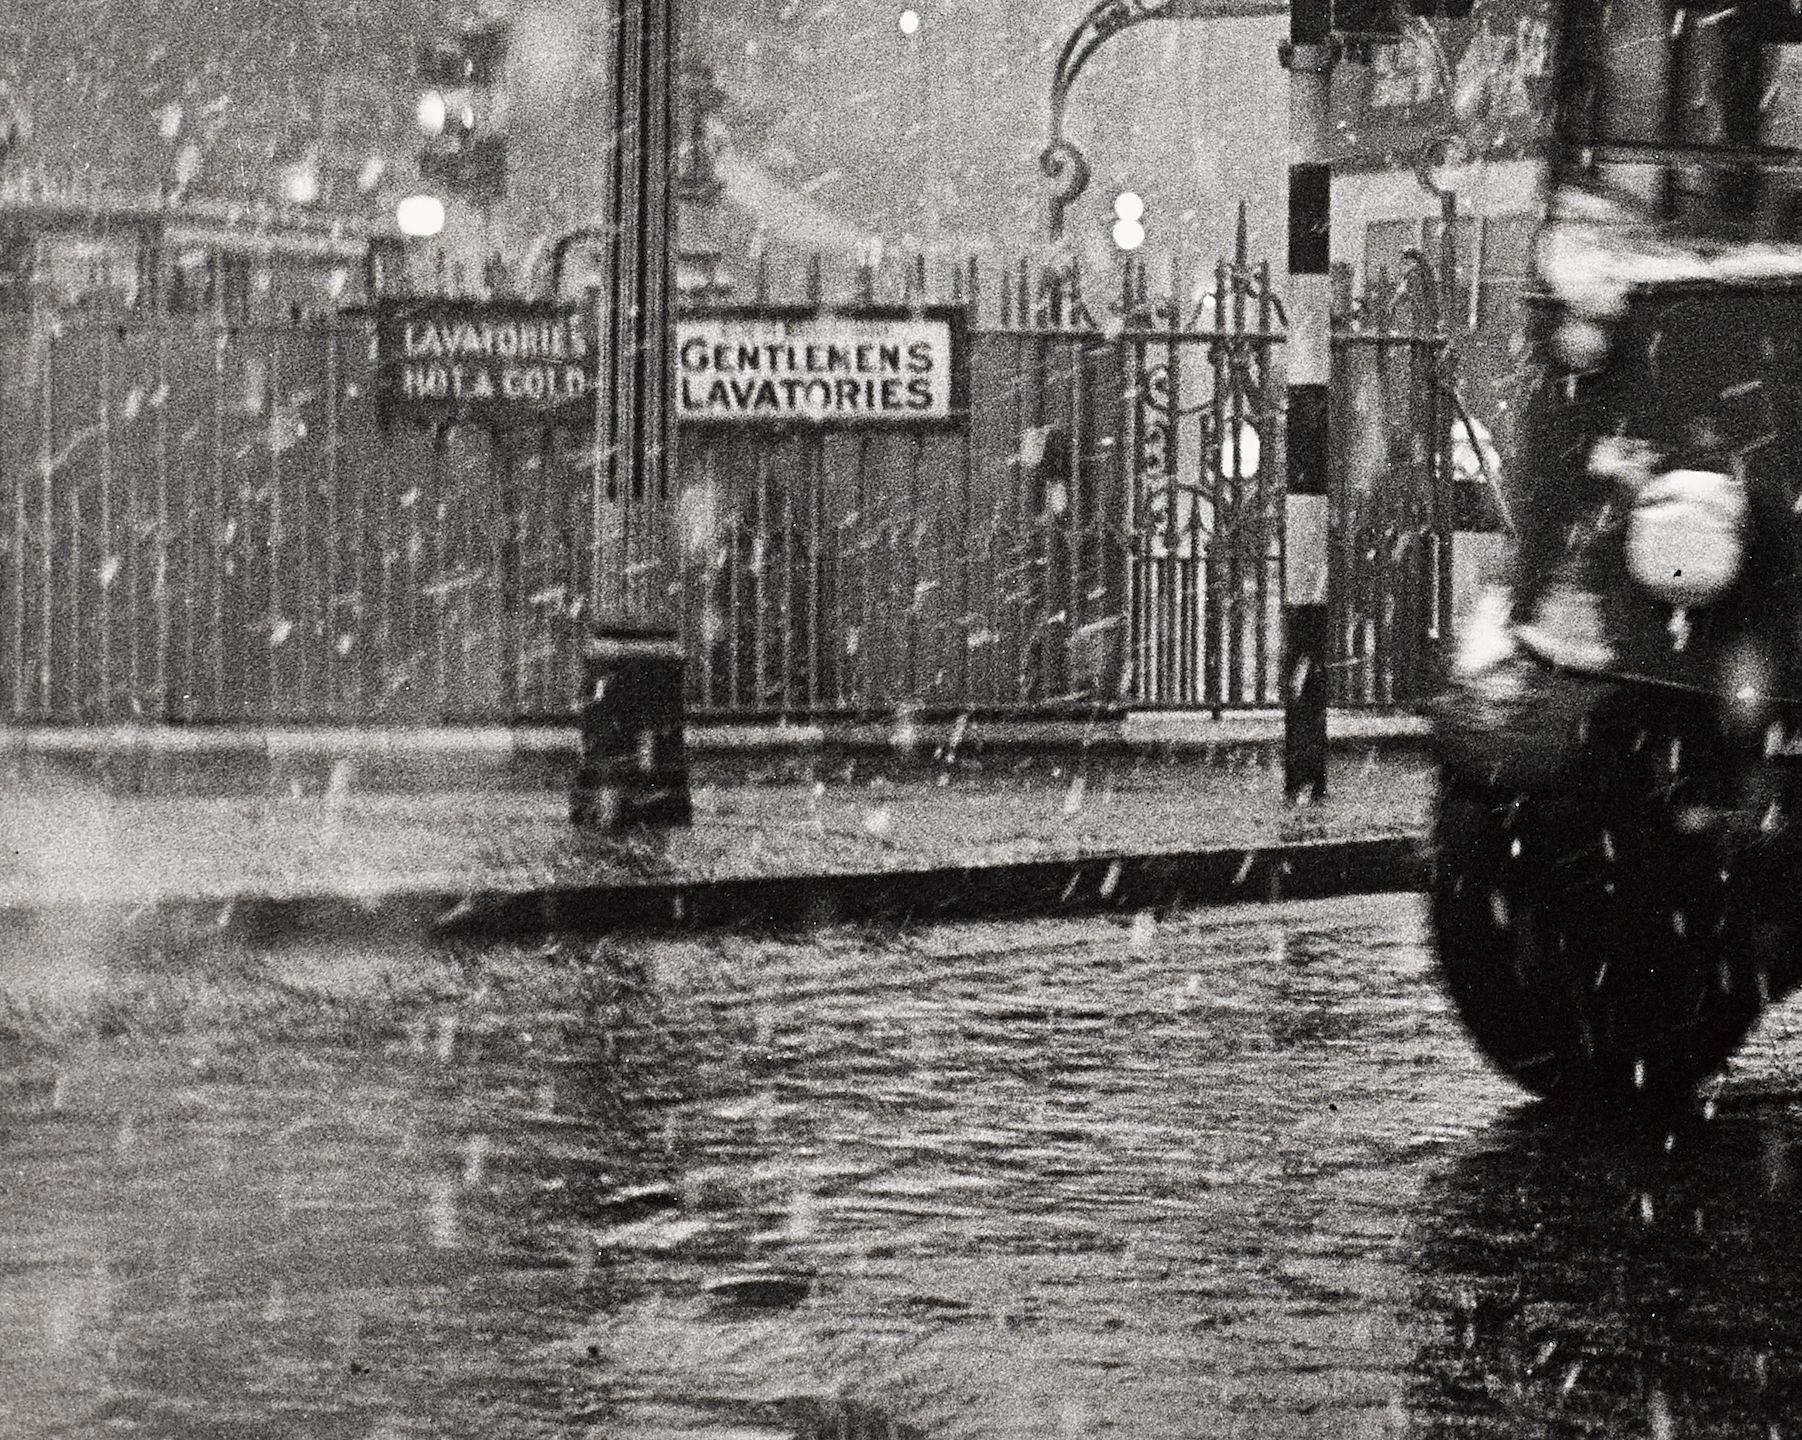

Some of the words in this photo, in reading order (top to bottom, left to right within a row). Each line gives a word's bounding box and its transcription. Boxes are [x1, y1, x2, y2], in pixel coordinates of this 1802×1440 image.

[402, 324, 588, 359] LAVATORIES
[678, 340, 932, 375] GENTLEMENS
[402, 366, 463, 398] HOT
[502, 368, 586, 399] COLD
[681, 379, 934, 413] LAVATORIES
